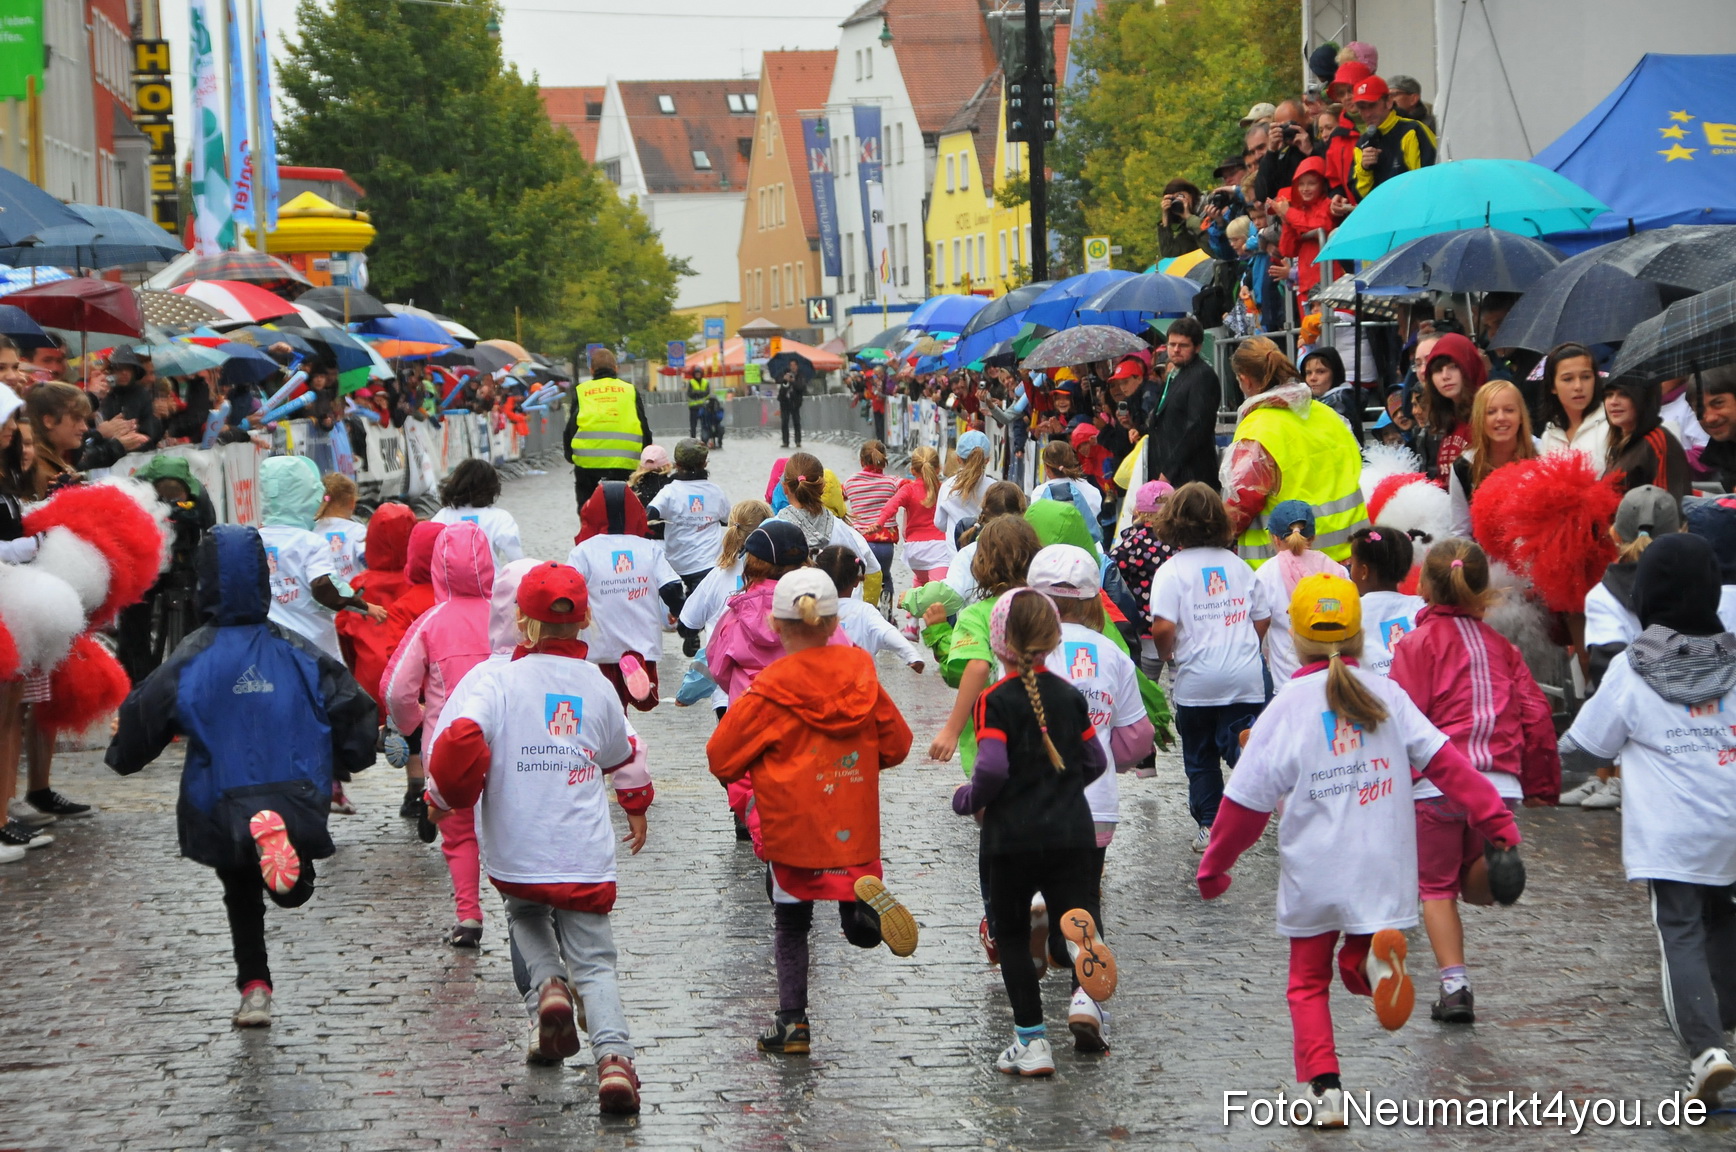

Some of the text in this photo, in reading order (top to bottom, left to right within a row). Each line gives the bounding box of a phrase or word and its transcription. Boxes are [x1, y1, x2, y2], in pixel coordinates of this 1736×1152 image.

[136, 43, 176, 230] HOTEL
[584, 386, 625, 397] HELFER
[283, 577, 296, 585] TV
[601, 577, 635, 586] neumarkt
[276, 589, 299, 604] 2011
[628, 587, 648, 600] 2011
[1193, 597, 1244, 610] neumarkt TV
[1225, 610, 1246, 627] 2011
[1101, 691, 1114, 705] TV
[1666, 725, 1727, 739] neumarkt
[521, 745, 597, 760] neumarkt TV
[1718, 747, 1736, 766] 20
[516, 760, 587, 772] Bambini-Lauf
[1311, 757, 1389, 782] neumarkt TV
[567, 765, 595, 785] 2011
[1309, 777, 1380, 800] Bambini-Lauf
[1359, 777, 1392, 806] 2011
